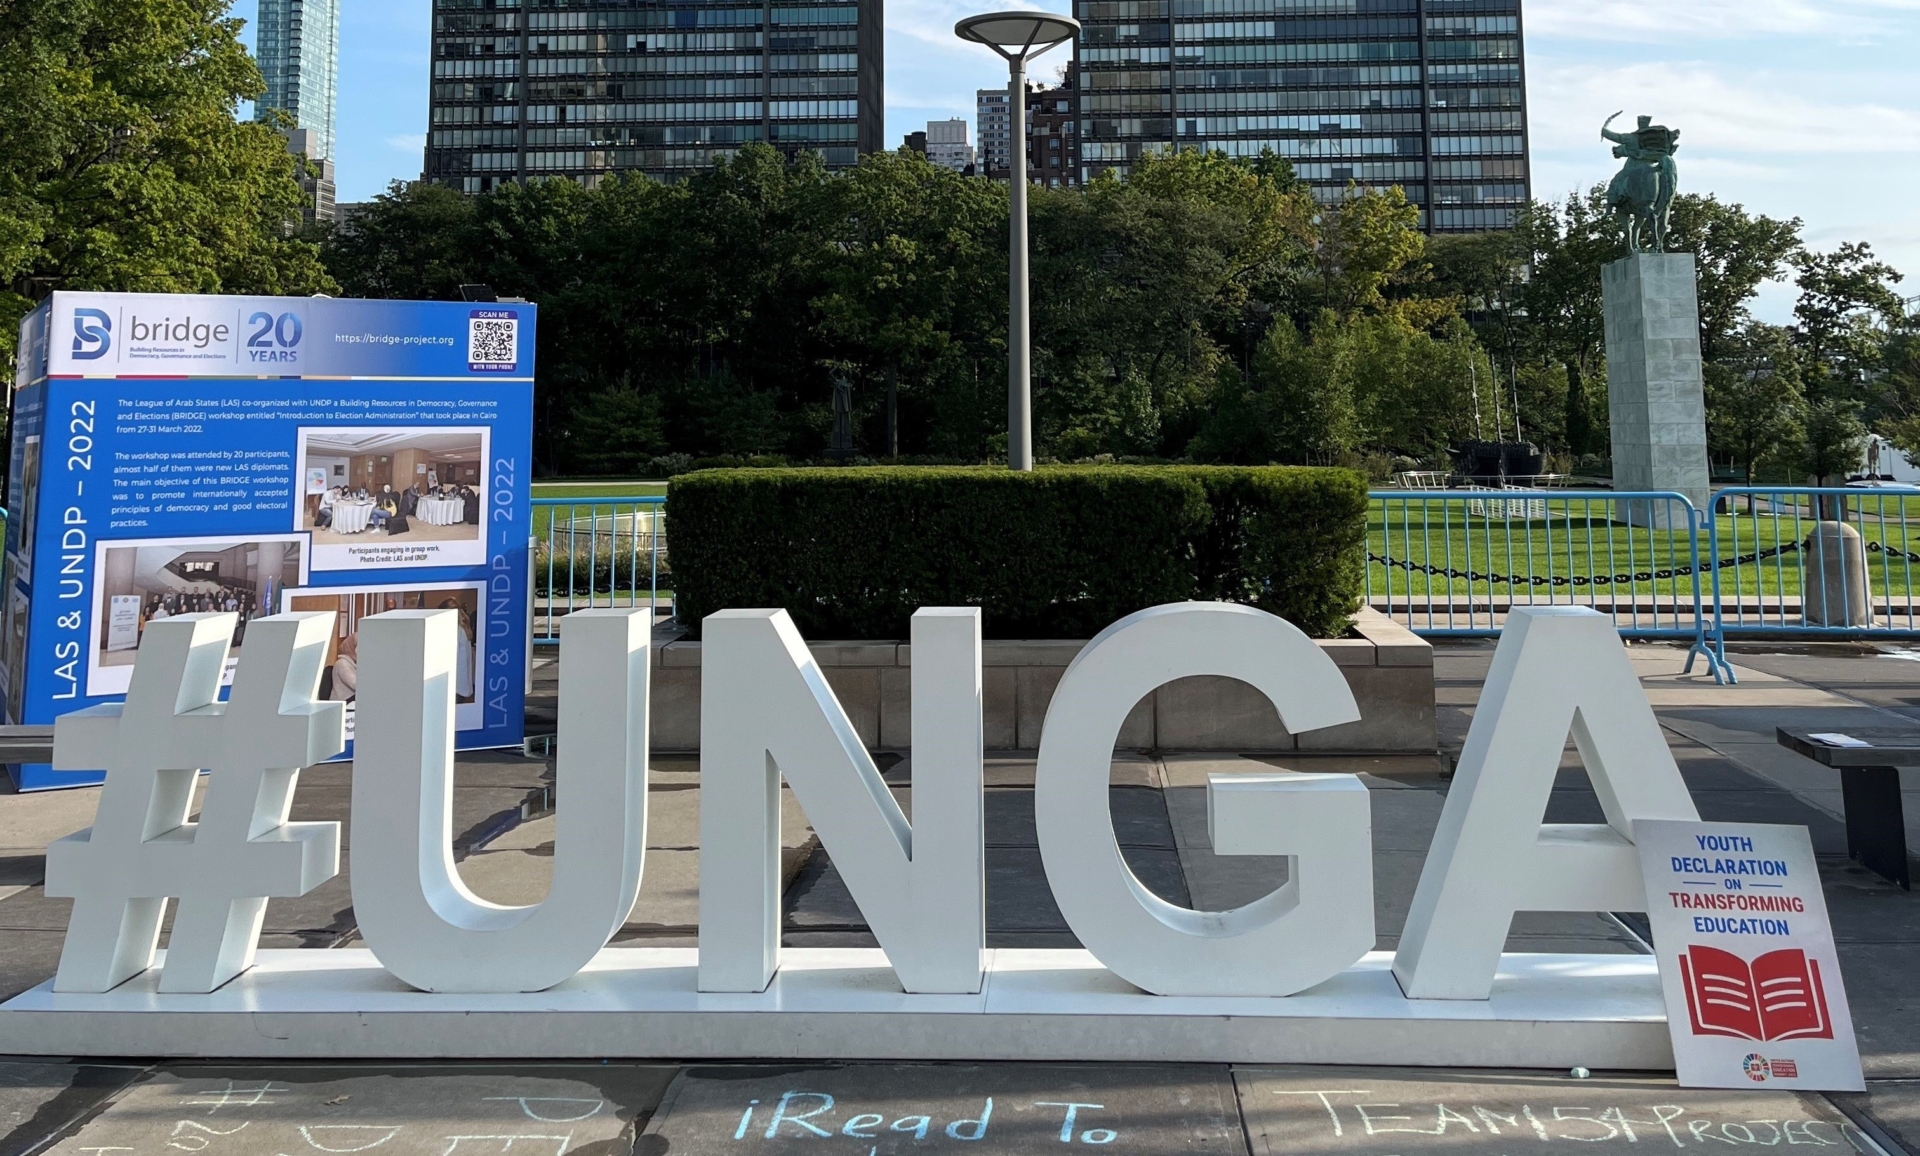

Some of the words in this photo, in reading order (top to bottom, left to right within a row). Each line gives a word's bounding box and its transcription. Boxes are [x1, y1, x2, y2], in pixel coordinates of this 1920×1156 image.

[131, 316, 229, 348] bridge
[247, 311, 302, 348] 20
[335, 334, 454, 346] https://bridge-project.org
[249, 351, 297, 362] YEARS
[118, 399, 133, 407] The
[135, 399, 163, 408] League
[176, 399, 193, 407] Arab
[196, 399, 219, 407] States
[221, 399, 240, 408] (LAS)
[242, 399, 289, 408] co-organized
[340, 400, 369, 408] Building
[417, 400, 456, 408] Democracy,
[172, 412, 206, 421] (BRIDGE)
[208, 412, 244, 421] workshop
[247, 412, 274, 420] entitled
[453, 412, 470, 420] place
[68, 401, 95, 471] 2022
[117, 426, 136, 434] from
[115, 452, 130, 460] The
[131, 452, 169, 461] workshop
[188, 451, 221, 459] attended
[224, 451, 233, 460] by
[245, 450, 290, 460] participants,
[114, 466, 141, 474] almost
[144, 465, 159, 473] half
[251, 463, 289, 472] diplomats.
[113, 479, 128, 487] The
[155, 478, 189, 487] objective
[203, 477, 217, 485] this
[253, 477, 289, 485] workshop
[494, 457, 515, 521] 2022
[152, 492, 185, 500] promote
[193, 490, 247, 499] internationally
[255, 489, 288, 498] accepted
[112, 505, 150, 515] principles
[167, 503, 209, 512] democracy
[213, 503, 228, 511] and
[232, 502, 252, 512] good
[256, 502, 287, 510] electoral
[110, 519, 148, 529] practices.
[59, 506, 87, 599] UNDP
[349, 547, 380, 555] Participants
[381, 546, 404, 554] engaging
[491, 554, 511, 638] UNDP
[58, 610, 81, 630] &
[490, 649, 509, 666] &
[52, 641, 80, 700] LAS
[489, 675, 508, 729] LAS
[44, 600, 1700, 1000] #UNGA
[1696, 835, 1753, 852] YOUTH
[1671, 857, 1788, 876] DECLARATION
[1725, 879, 1742, 890] ON
[1669, 892, 1804, 912] TRANSFORMING
[1694, 916, 1790, 936] EDUCATION
[1035, 1099, 1117, 1145] To
